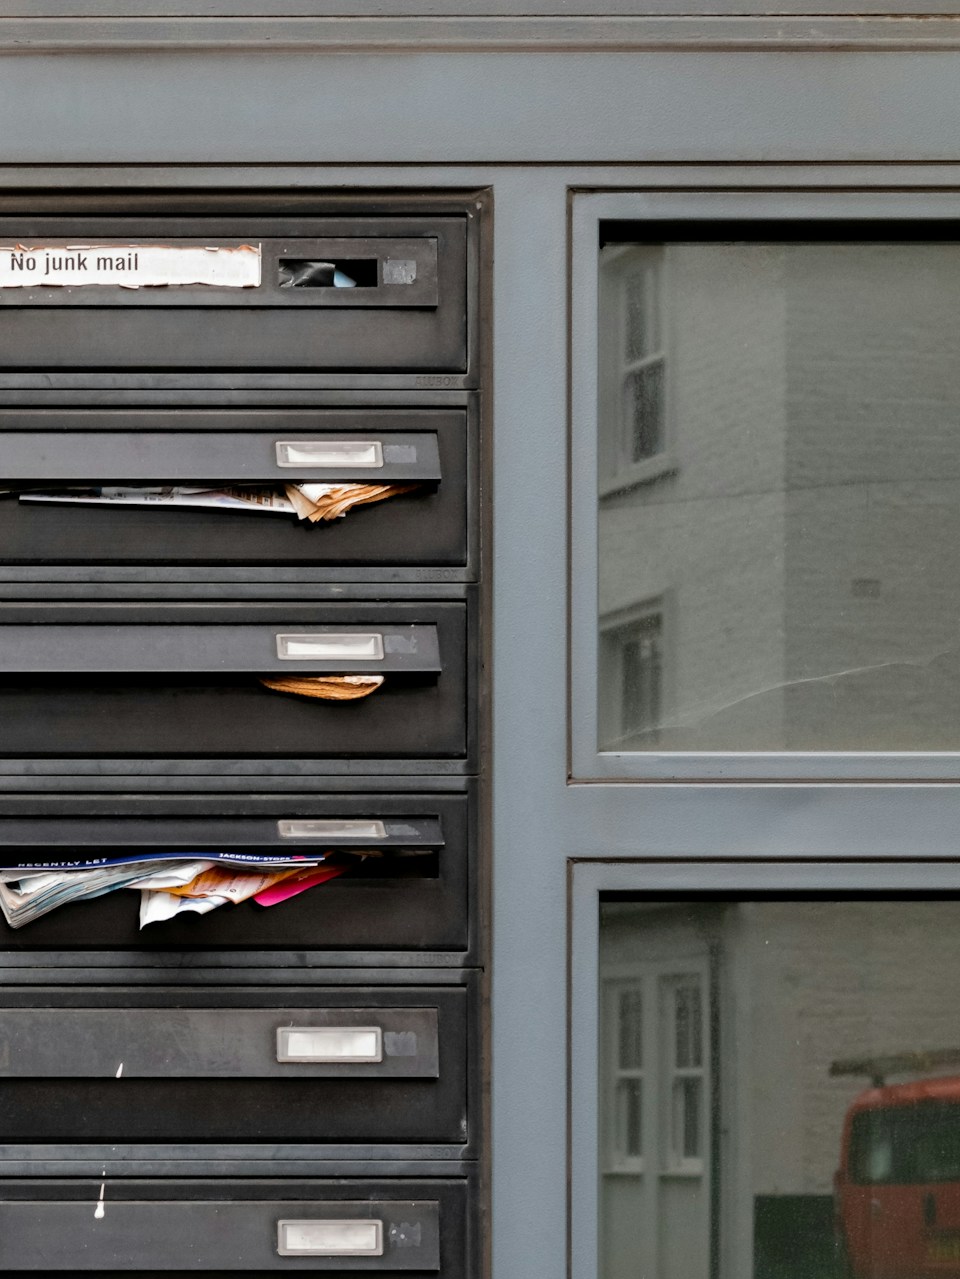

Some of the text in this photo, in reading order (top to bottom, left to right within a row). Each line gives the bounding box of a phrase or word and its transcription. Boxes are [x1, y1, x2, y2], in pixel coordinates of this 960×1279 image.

[10, 252, 139, 275] No junk mail
